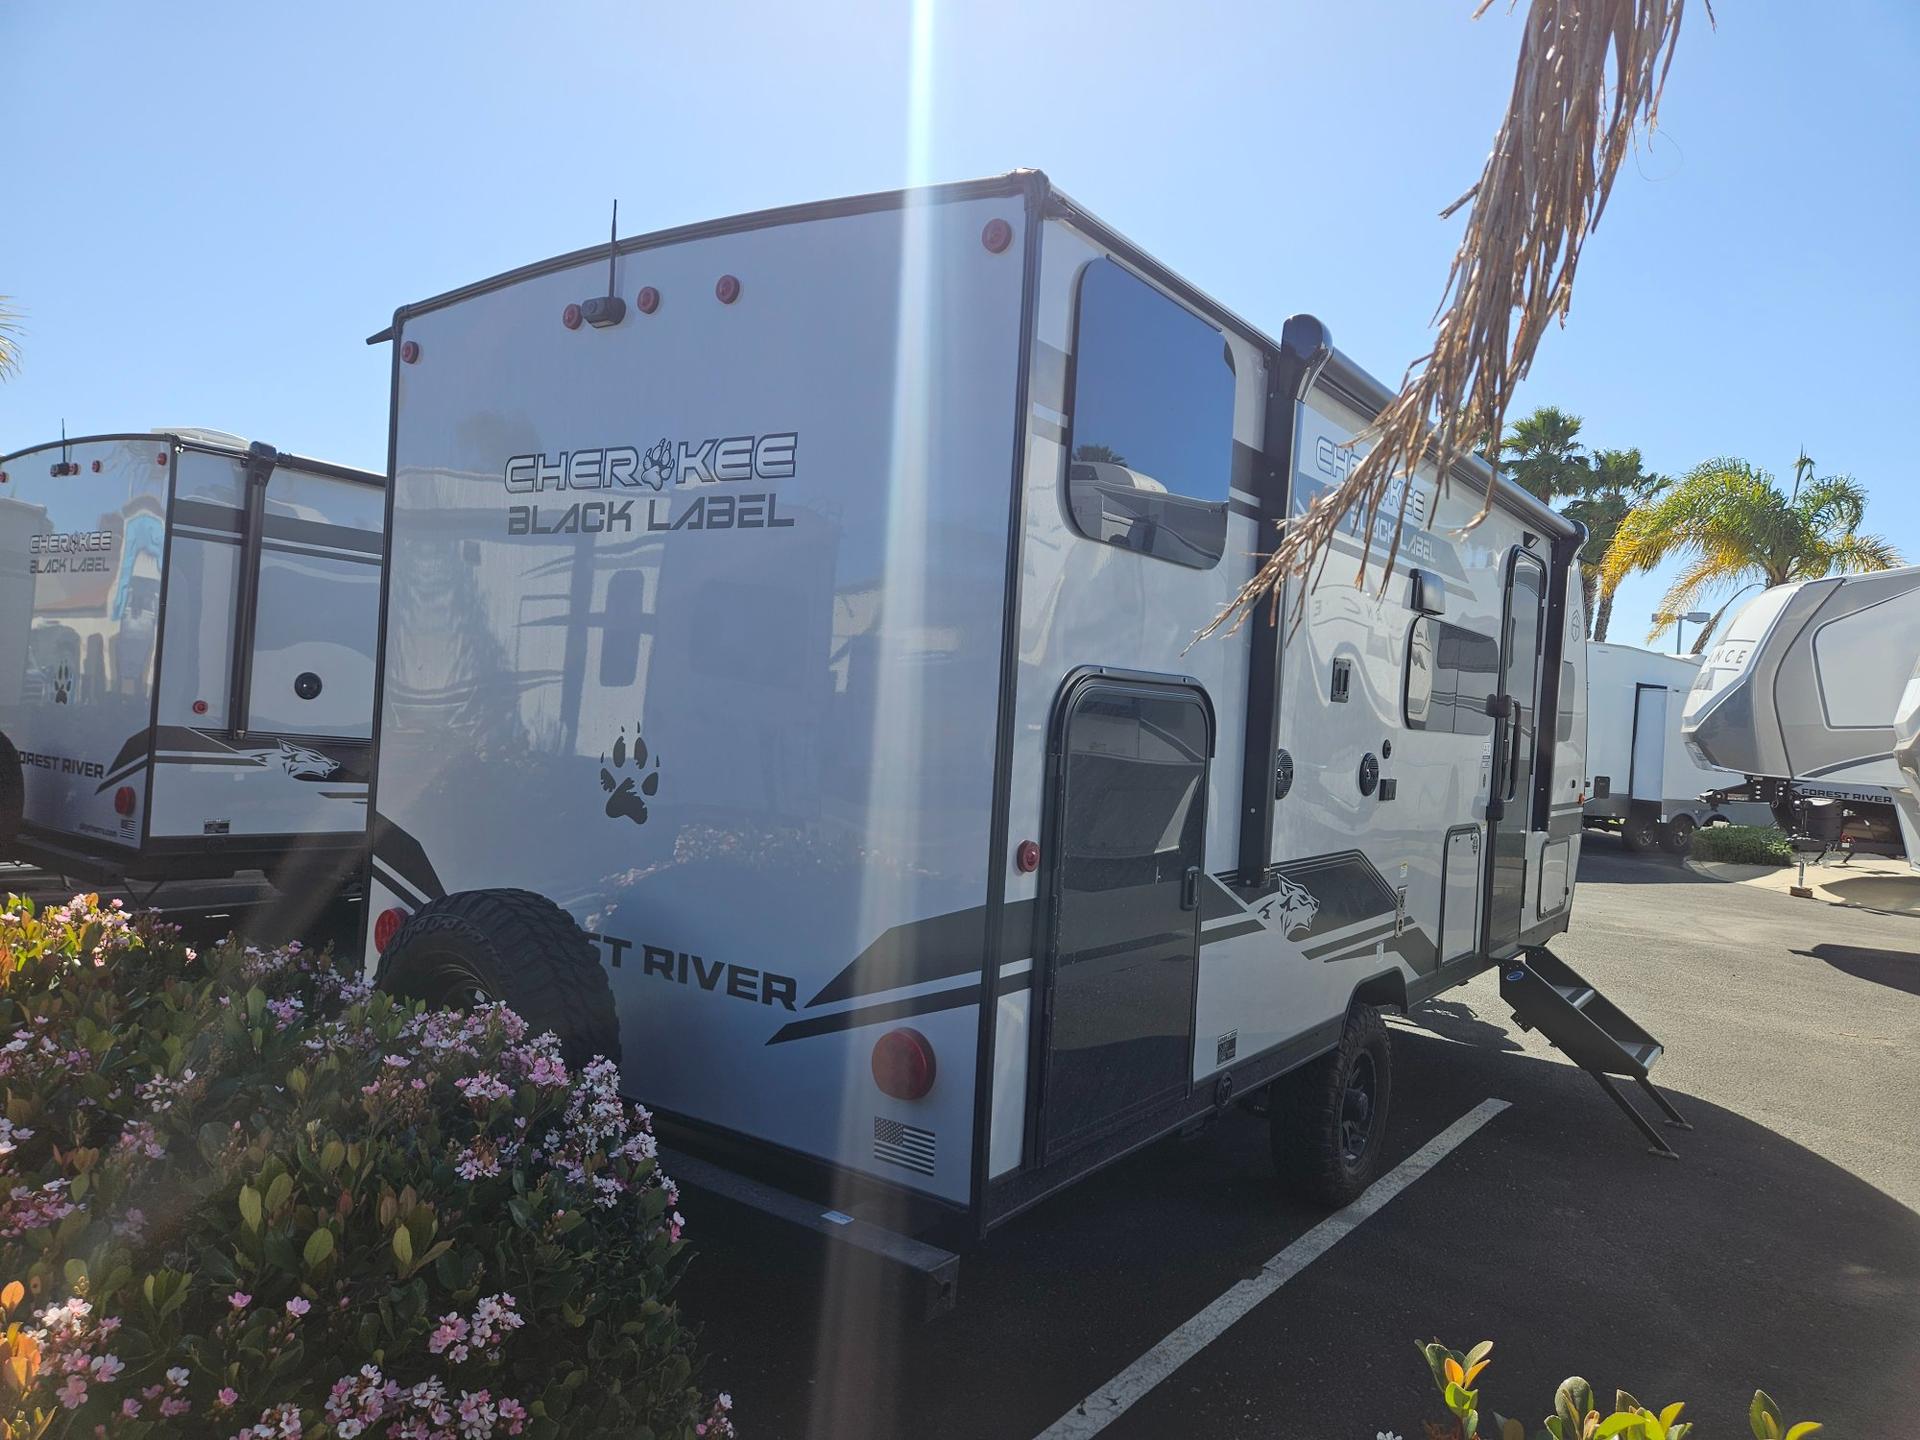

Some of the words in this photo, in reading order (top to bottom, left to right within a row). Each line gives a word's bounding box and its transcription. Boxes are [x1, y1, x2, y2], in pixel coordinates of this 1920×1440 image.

[508, 500, 635, 535] BLACK
[647, 493, 795, 531] LABEL
[1399, 527, 1436, 563] LABEL
[30, 558, 67, 574] BLACK
[69, 556, 110, 573] LABEL
[61, 758, 104, 779] RIVER
[1801, 788, 1850, 799] FOREST
[1852, 793, 1892, 803] RIVER
[642, 944, 797, 1012] RIVER
